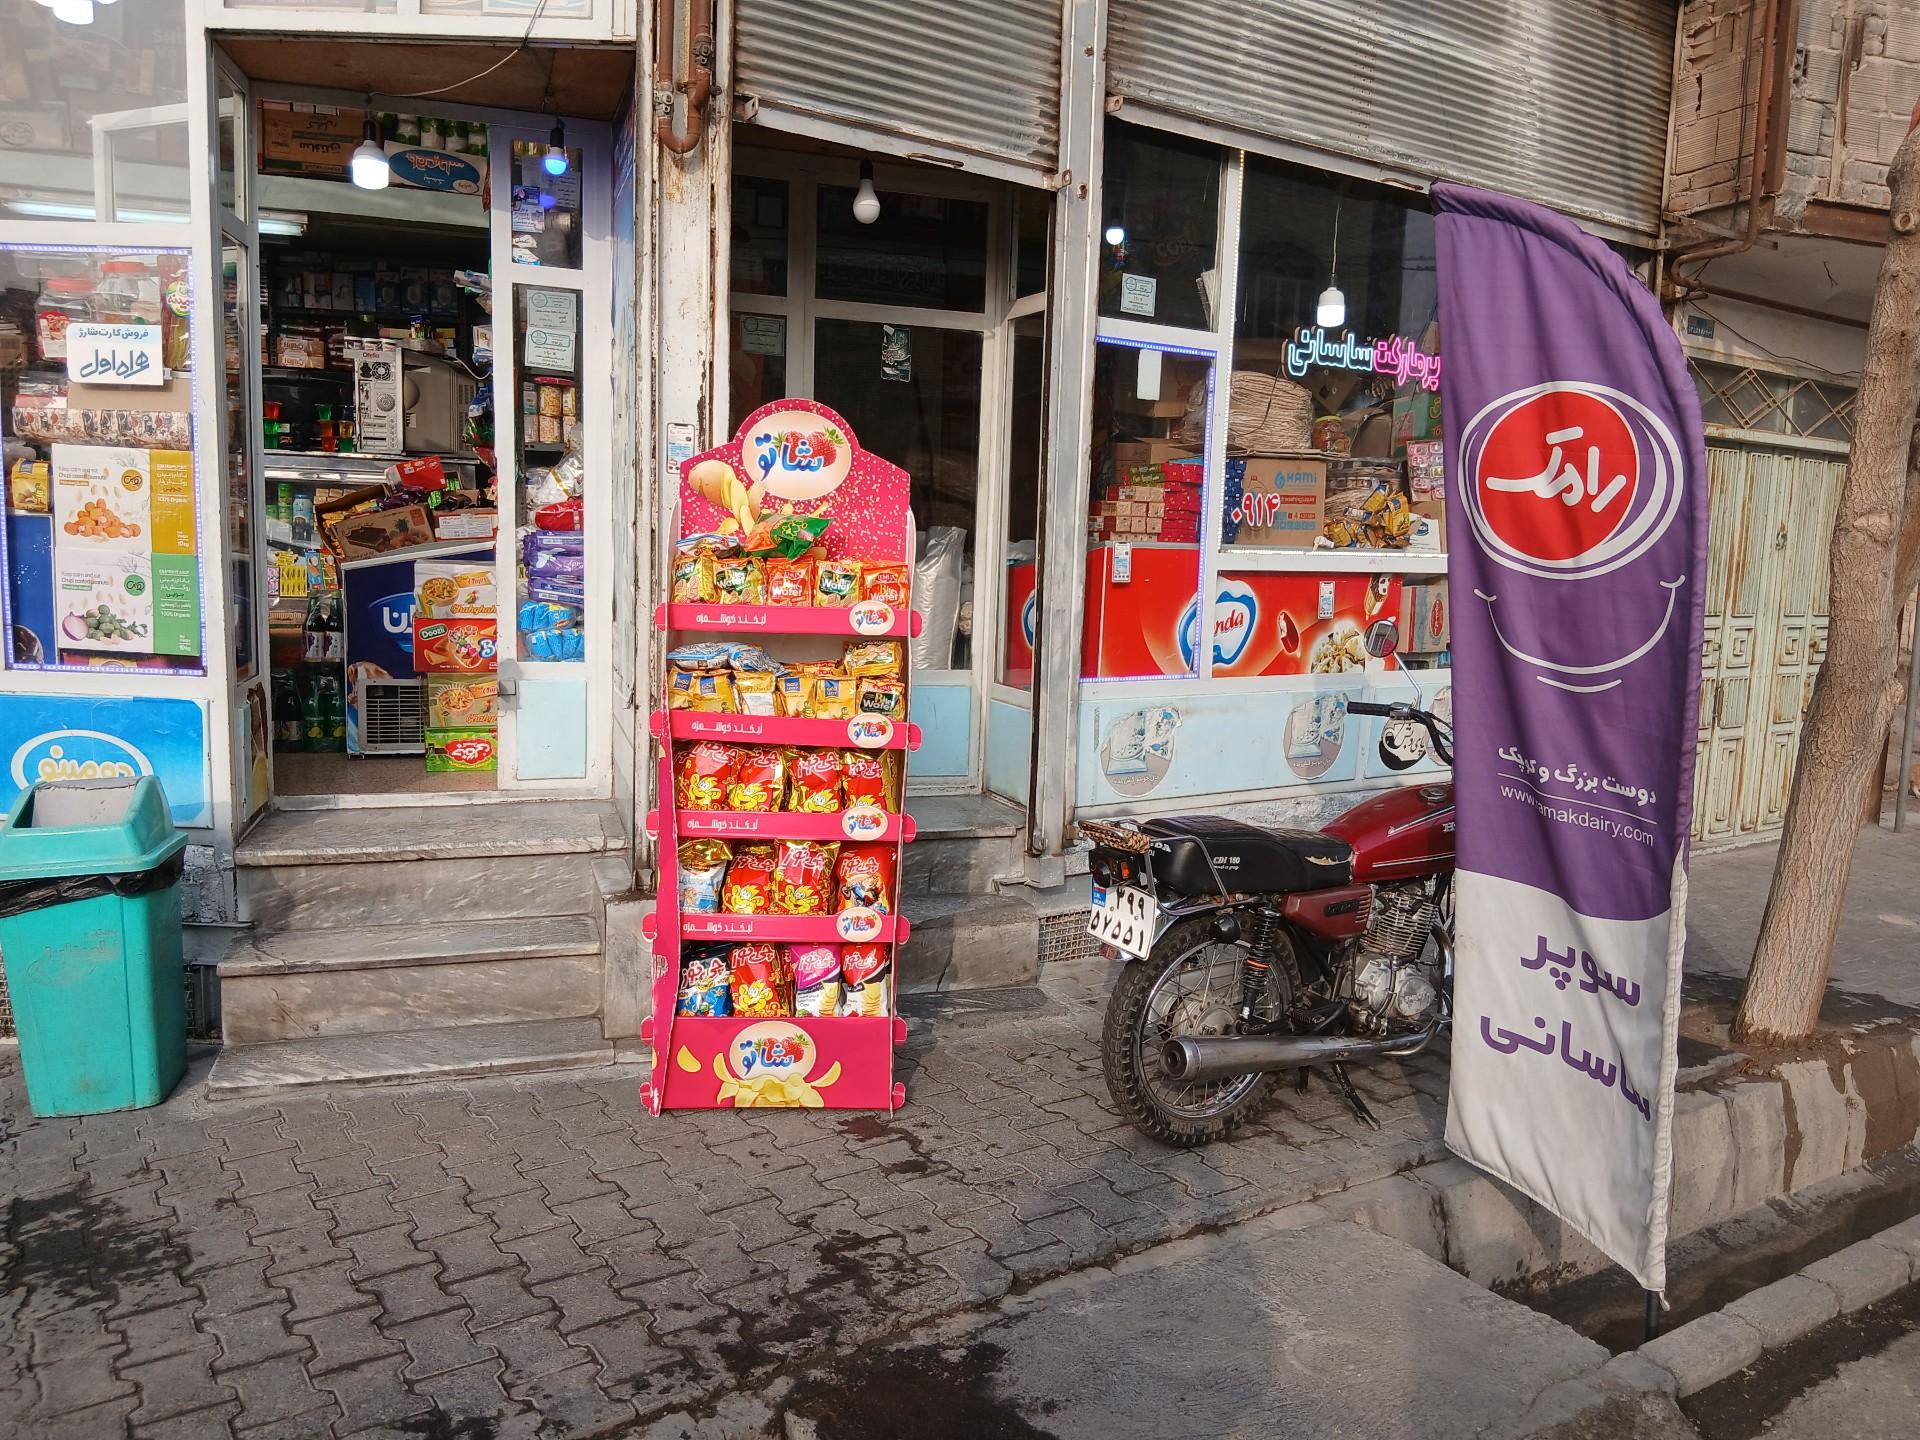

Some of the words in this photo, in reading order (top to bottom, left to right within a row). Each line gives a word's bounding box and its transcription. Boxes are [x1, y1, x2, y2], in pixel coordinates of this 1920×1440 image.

[78, 328, 99, 339] شارژ
[99, 328, 122, 338] کارت
[123, 328, 149, 339] فروش
[80, 349, 116, 378] اول
[1287, 328, 1374, 377] ساسانی
[754, 433, 823, 481] شاتو
[1486, 426, 1627, 513] رامک
[1231, 492, 1281, 527] ۰۹۱۴
[771, 587, 803, 597] Wafer
[821, 578, 851, 590] Wafer
[870, 592, 898, 602] Wafer
[855, 610, 884, 629] شاتو
[1213, 608, 1244, 637] nda
[863, 699, 894, 712] Wafer
[853, 722, 881, 741] شاتو
[1538, 766, 1550, 783] و
[1554, 763, 1599, 793] بزرگ
[1601, 776, 1657, 806] دوست
[847, 815, 875, 833] شاتو
[1213, 856, 1227, 864] CDI
[1116, 887, 1145, 920] ۳۹۹
[842, 917, 870, 935] شاتو
[1090, 910, 1144, 953] ۵۷۵۵۱
[1519, 934, 1641, 1007] سوپر
[740, 1040, 795, 1076] شاتو
[1480, 1015, 1651, 1122] ساسانی
